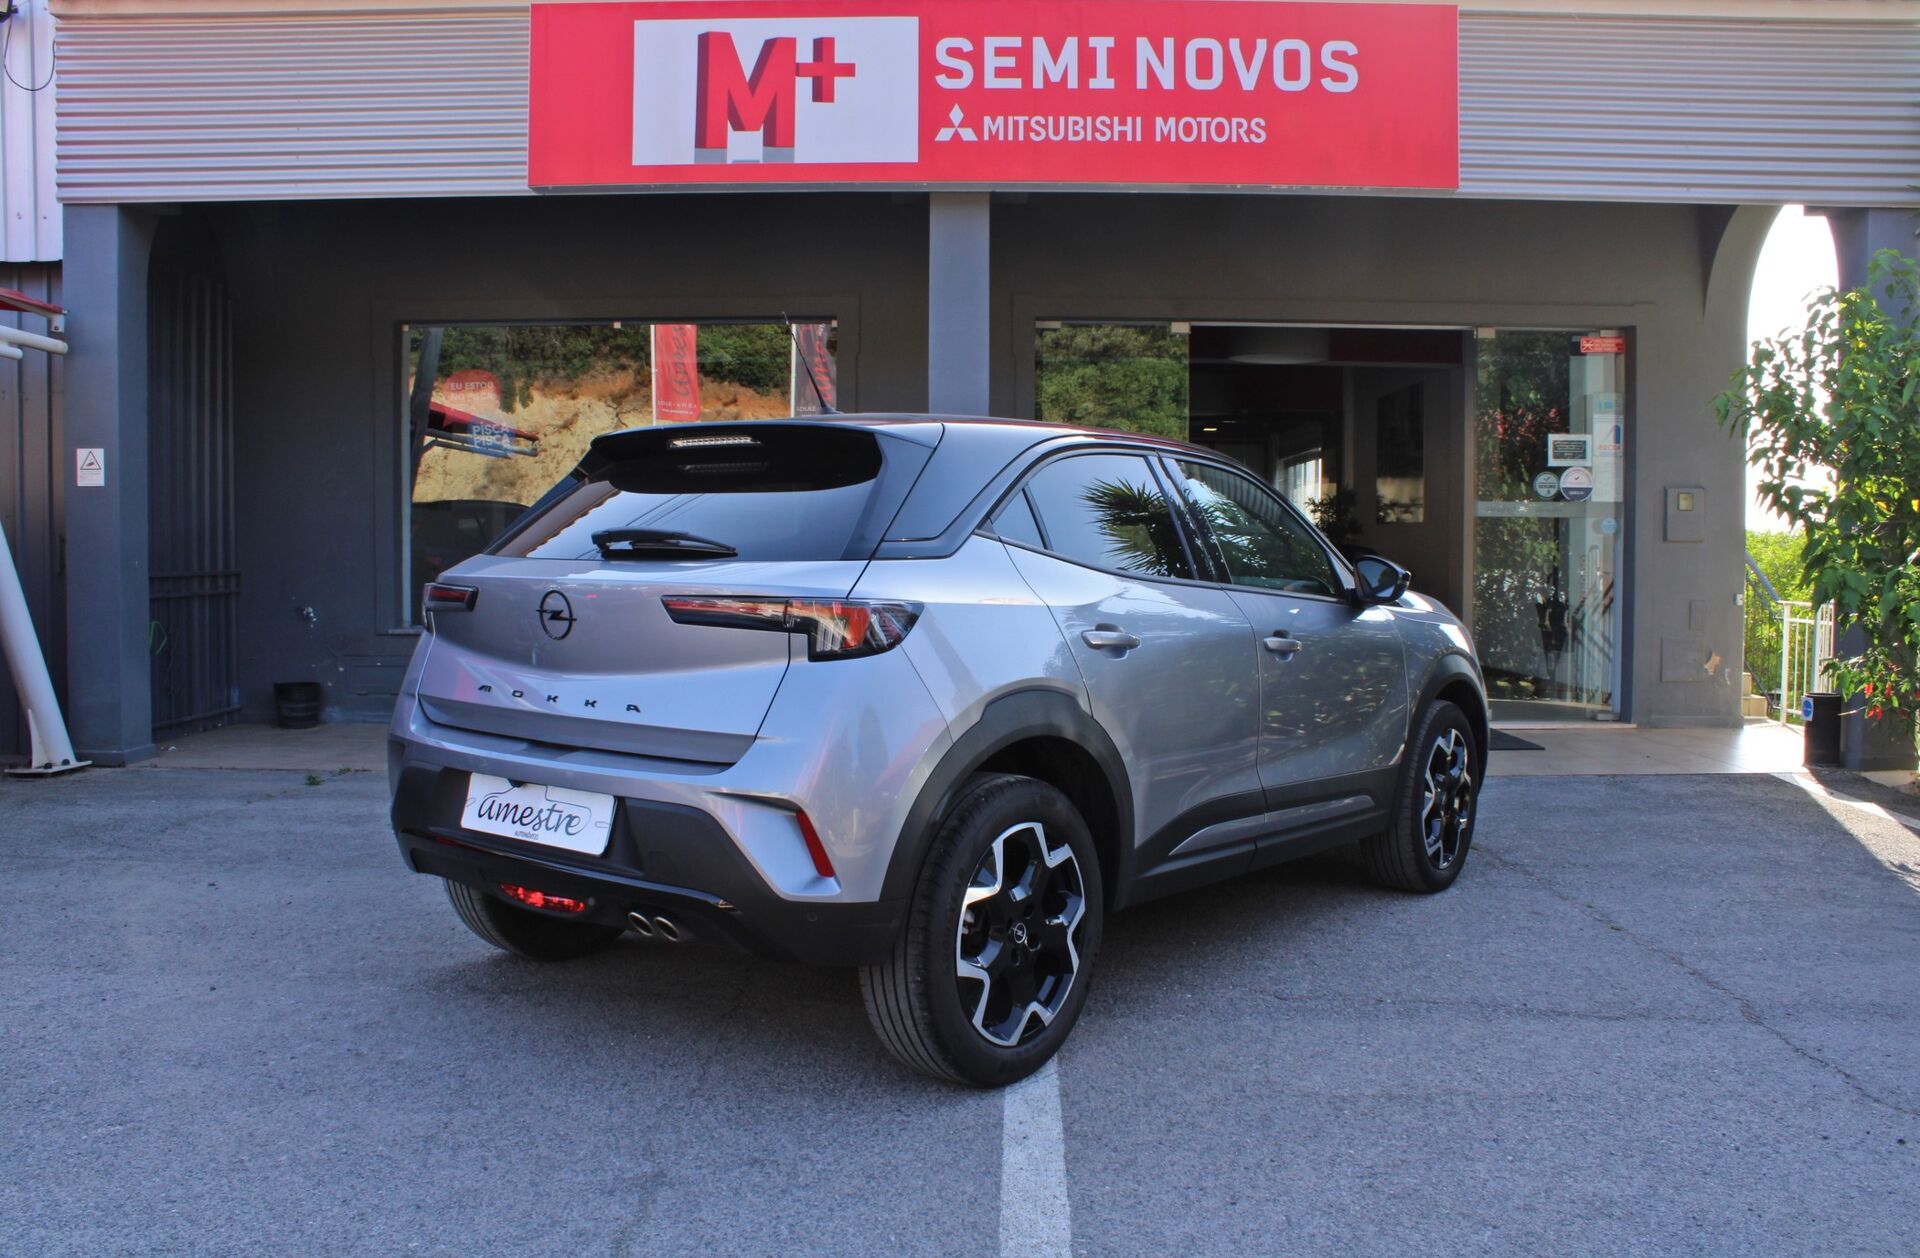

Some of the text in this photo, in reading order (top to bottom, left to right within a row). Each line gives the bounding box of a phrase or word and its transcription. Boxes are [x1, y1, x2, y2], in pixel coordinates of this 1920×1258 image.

[935, 36, 1359, 93] SEMI NOVOS
[983, 115, 1267, 143] MITSUBISHI MOTORS
[472, 421, 510, 436] PISCA
[473, 433, 512, 448] PISCA
[478, 684, 641, 713] MOKKA
[478, 795, 585, 836] amestre
